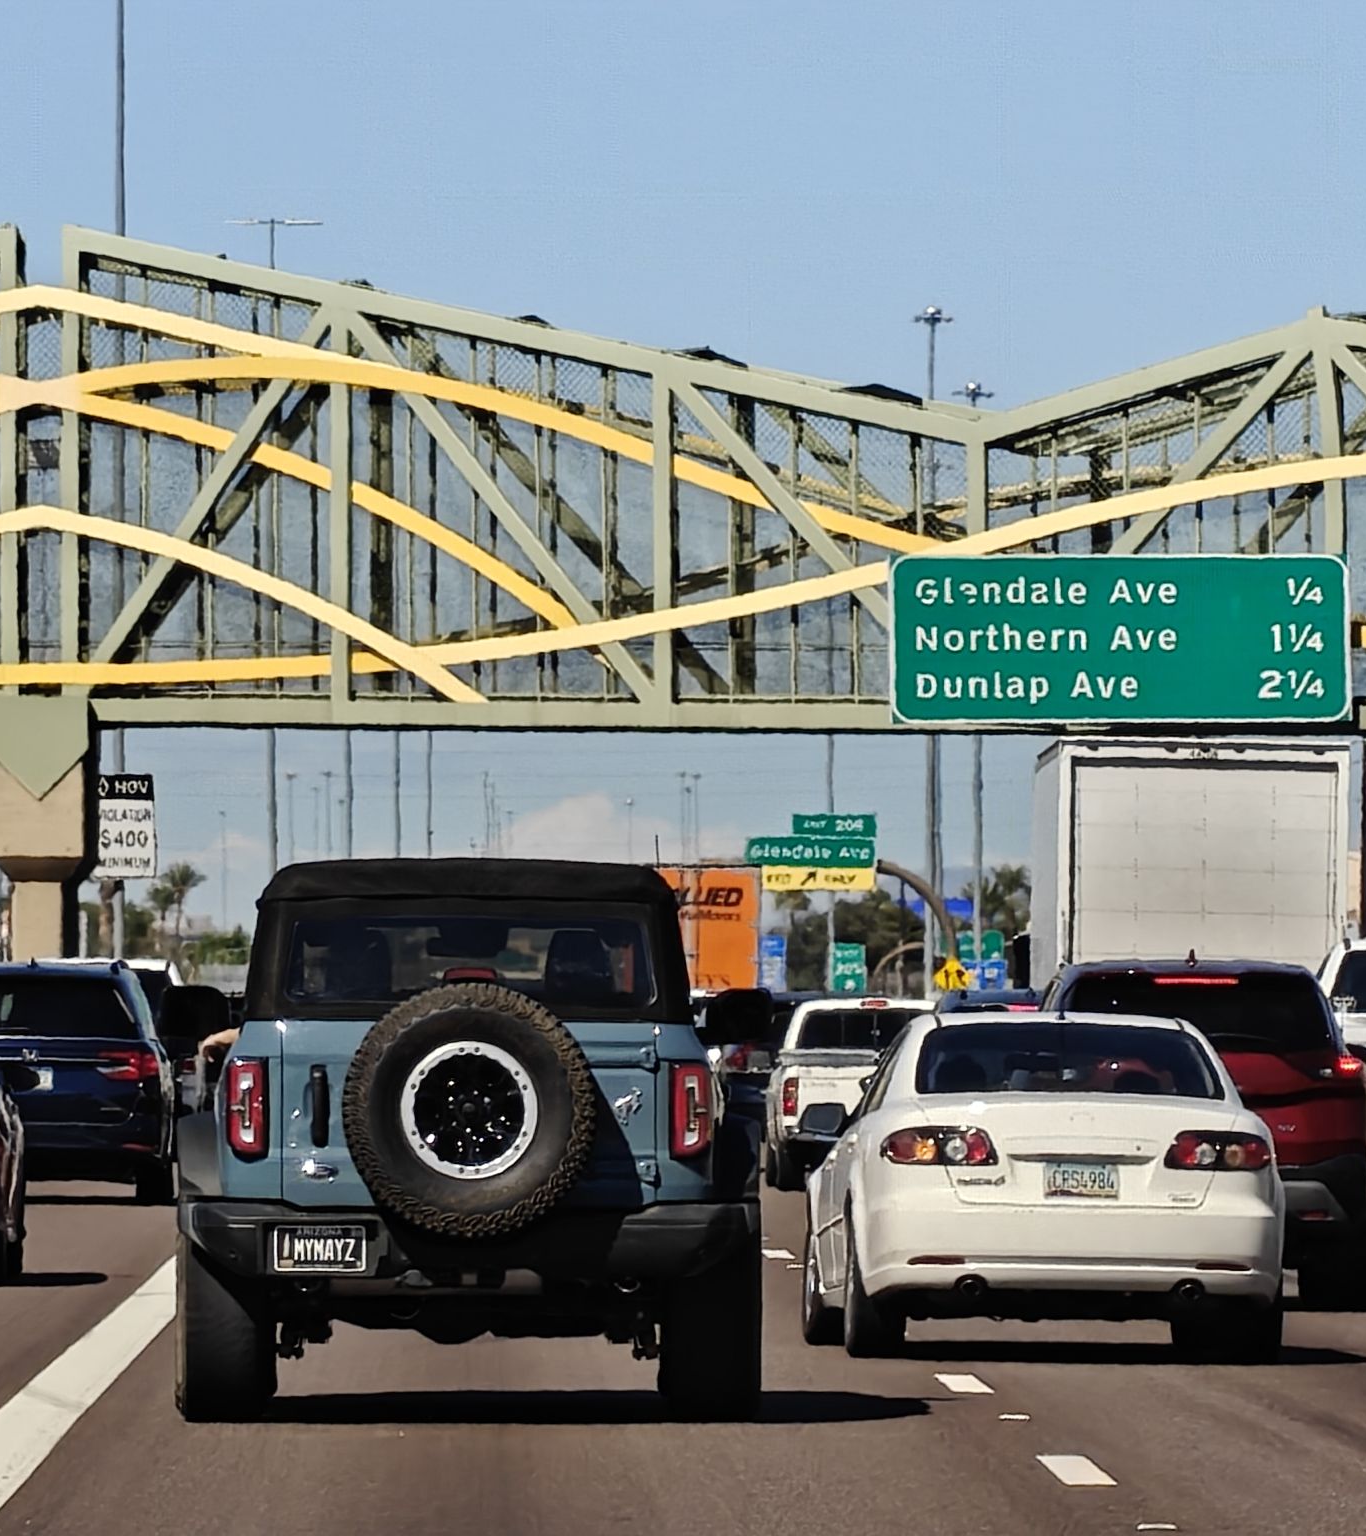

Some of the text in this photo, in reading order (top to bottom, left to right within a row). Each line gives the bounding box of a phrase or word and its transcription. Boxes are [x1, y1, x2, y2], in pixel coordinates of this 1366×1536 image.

[915, 576, 1087, 604] Glendale
[1109, 579, 1177, 604] Ave
[915, 623, 1087, 651] Northern
[1110, 625, 1177, 651] Ave
[916, 671, 1049, 704] Dunlap
[1070, 671, 1138, 699] Ave
[115, 780, 149, 794] HOV
[101, 828, 148, 850] $400
[749, 844, 870, 860] Glendale Ave
[293, 1238, 356, 1262] MYMAYZ
